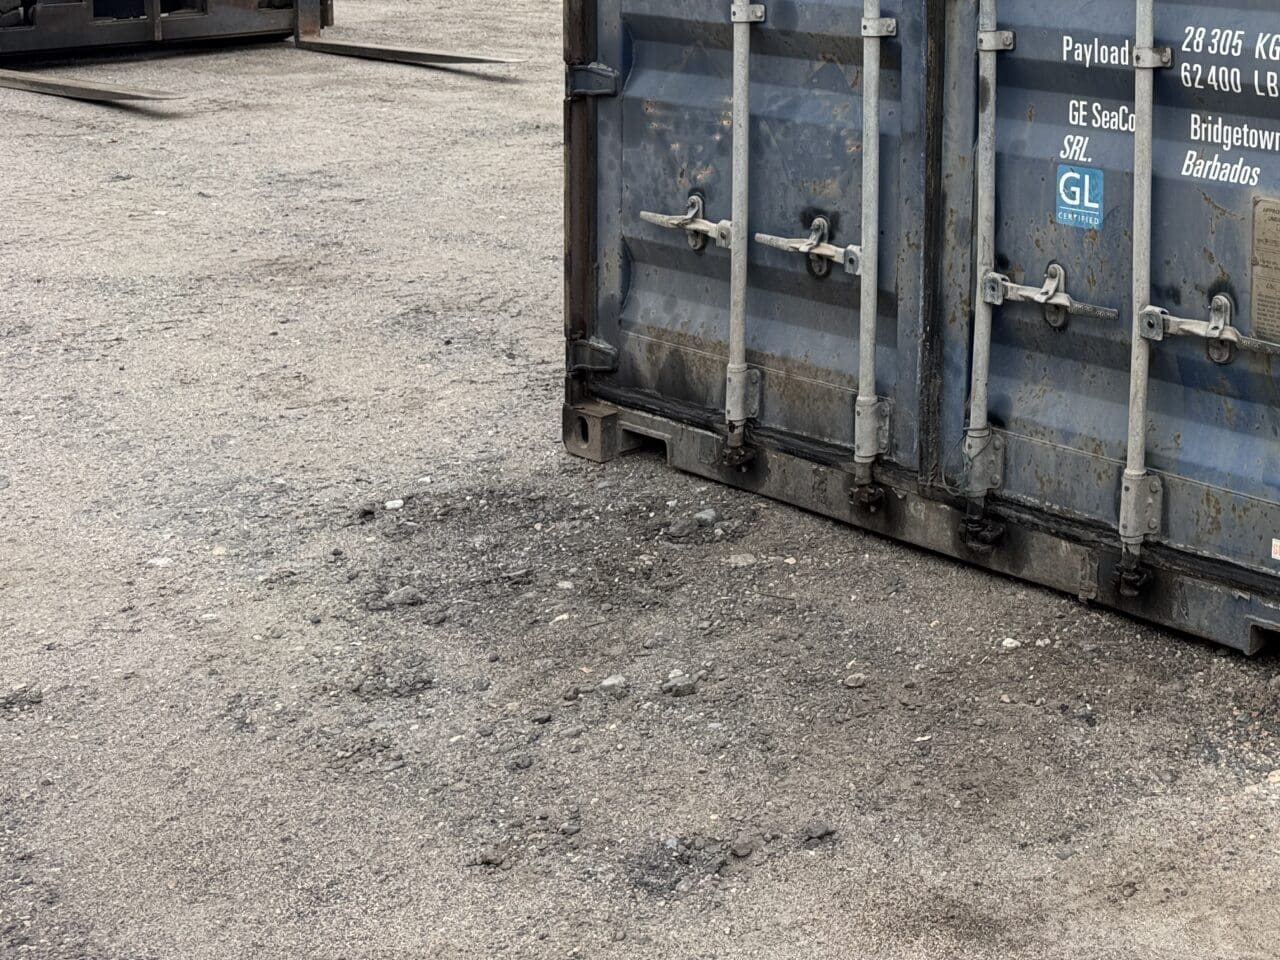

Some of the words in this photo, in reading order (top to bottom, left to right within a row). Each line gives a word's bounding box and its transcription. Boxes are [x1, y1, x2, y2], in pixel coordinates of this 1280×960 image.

[1062, 35, 1129, 68] Payload
[1068, 99, 1088, 127] GE
[1091, 102, 1136, 133] SeaCo
[1059, 134, 1092, 163] SRL.
[1181, 150, 1261, 187] Barbados
[1059, 171, 1099, 209] GL
[1058, 211, 1100, 225] CERTIFIED
